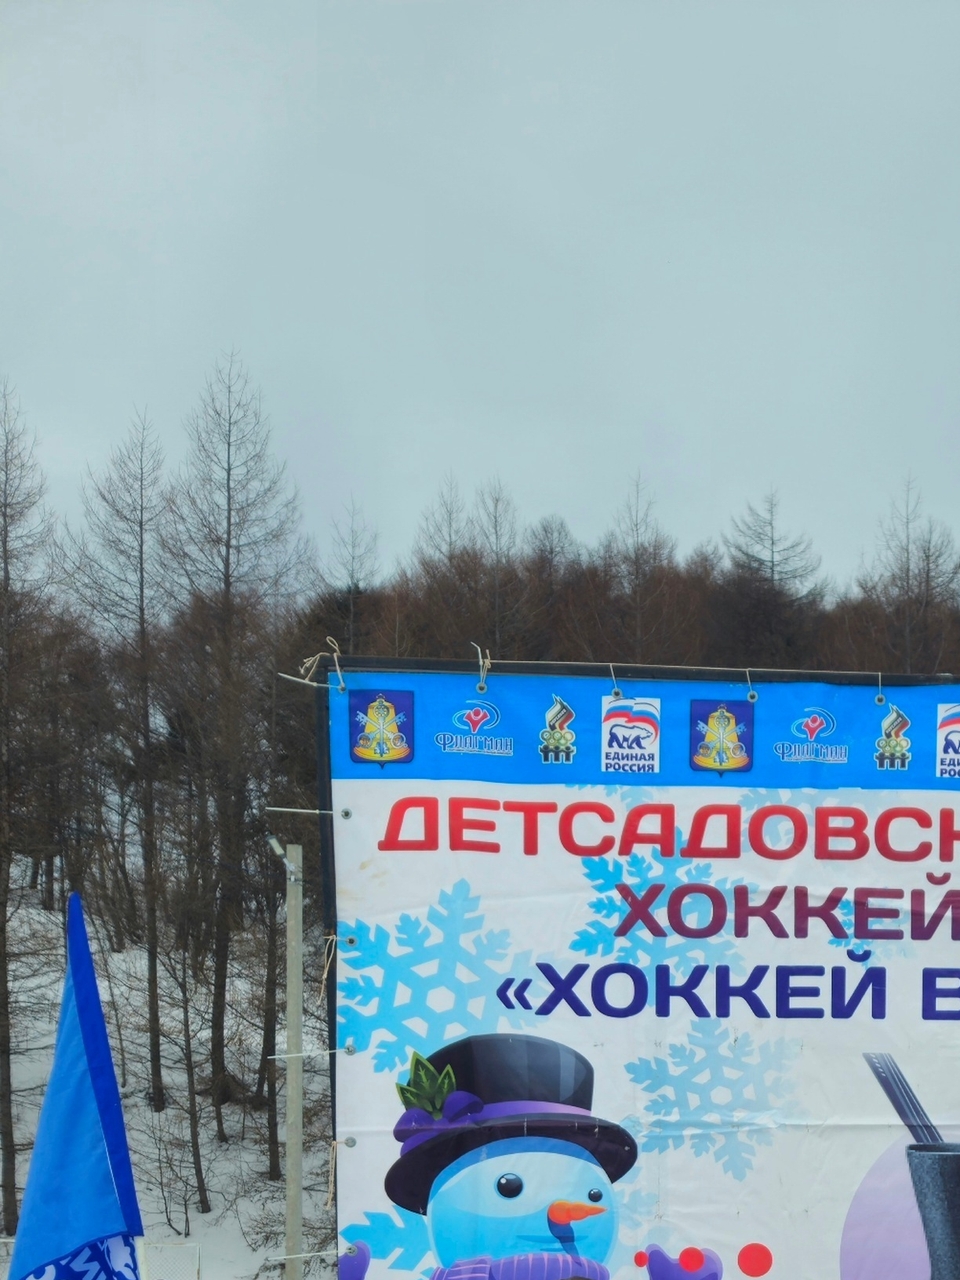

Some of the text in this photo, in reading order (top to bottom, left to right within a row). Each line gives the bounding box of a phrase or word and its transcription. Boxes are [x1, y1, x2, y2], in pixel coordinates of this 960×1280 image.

[605, 752, 655, 761] ЕДИНАЯ
[605, 762, 655, 772] РОССИЯ
[496, 949, 887, 1021] «ХОККЕЙ
